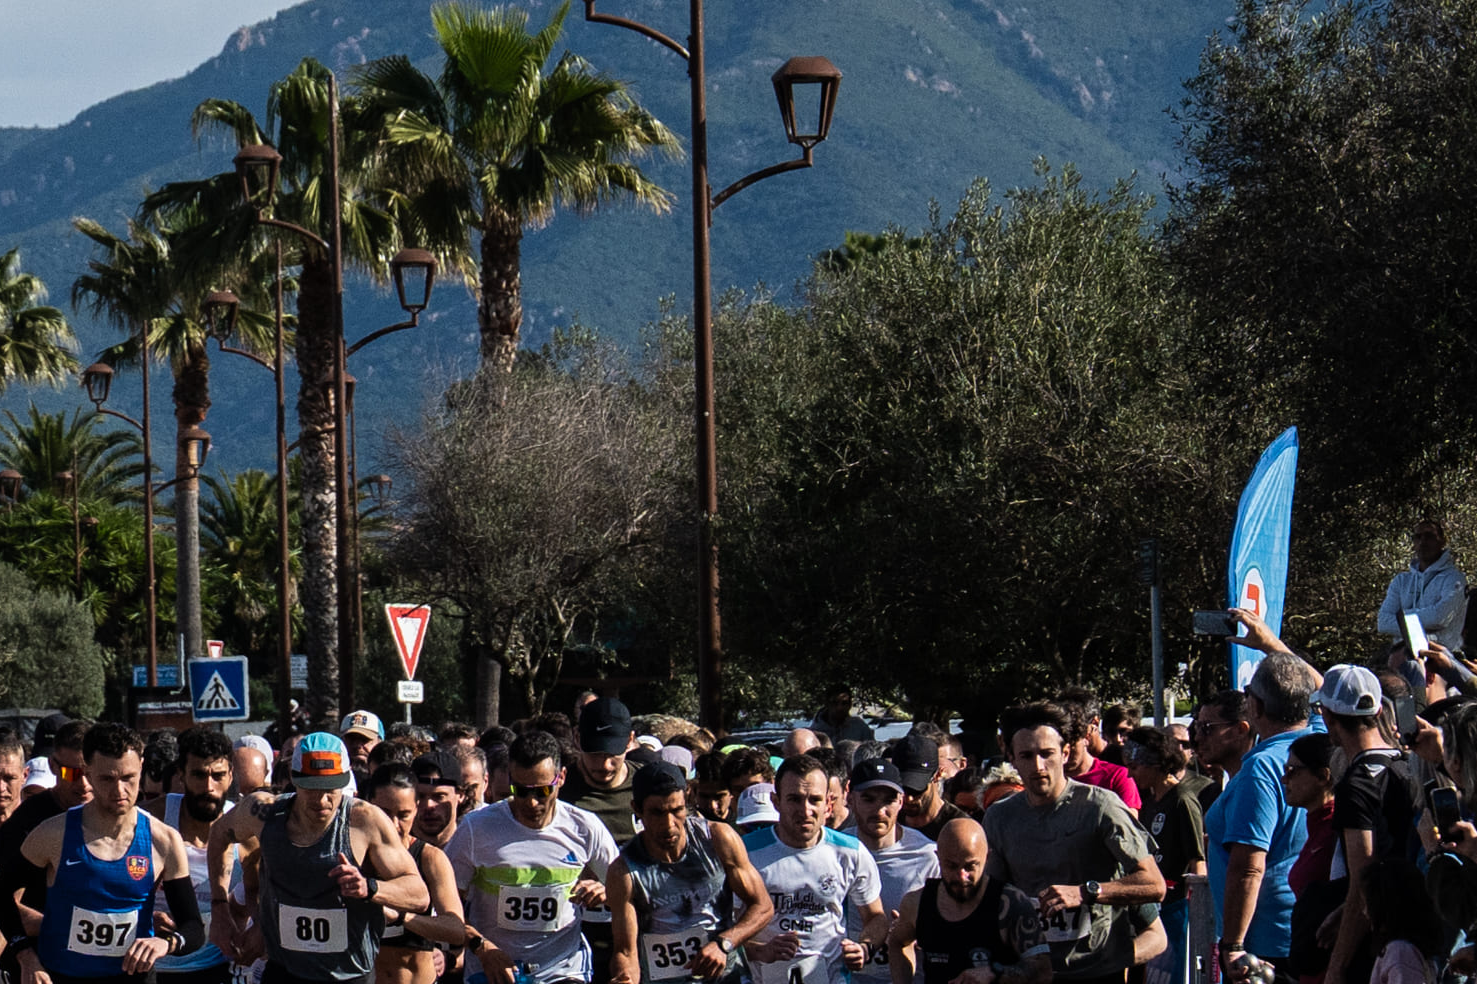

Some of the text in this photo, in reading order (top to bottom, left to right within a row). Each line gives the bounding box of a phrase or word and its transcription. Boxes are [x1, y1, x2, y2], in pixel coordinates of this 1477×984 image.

[504, 896, 559, 922] 359
[76, 919, 132, 947] 397
[296, 916, 330, 942] 80
[652, 936, 703, 968] 353
